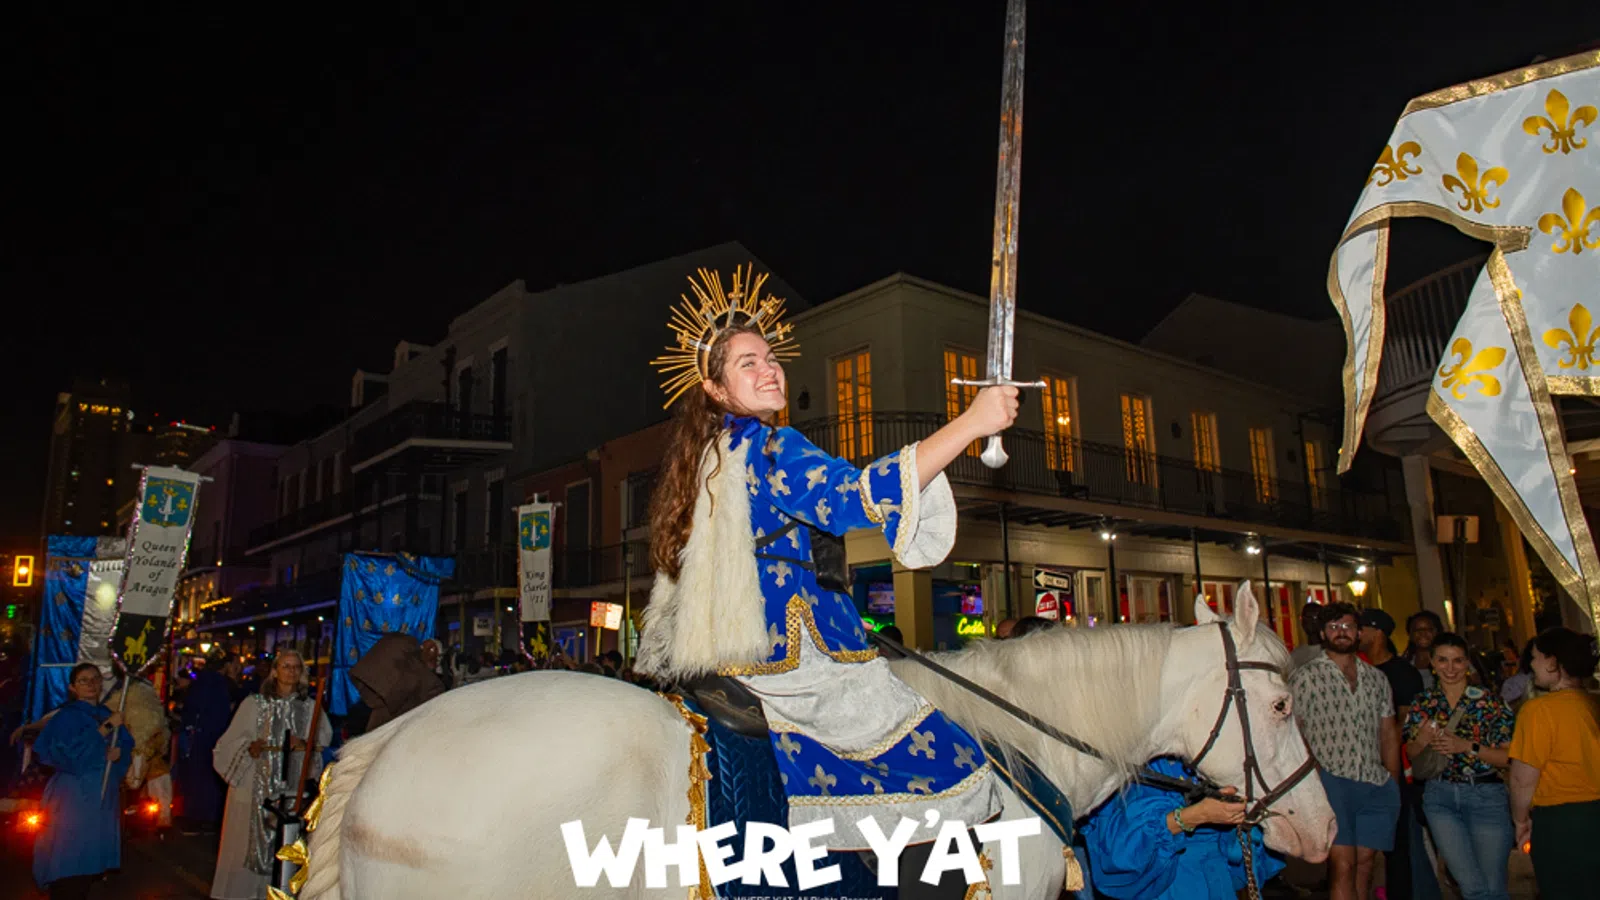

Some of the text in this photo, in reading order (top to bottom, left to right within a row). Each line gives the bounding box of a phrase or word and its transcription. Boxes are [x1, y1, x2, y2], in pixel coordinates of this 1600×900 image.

[142, 541, 176, 553] Queen
[149, 569, 164, 582] of
[128, 582, 169, 596] Aragon
